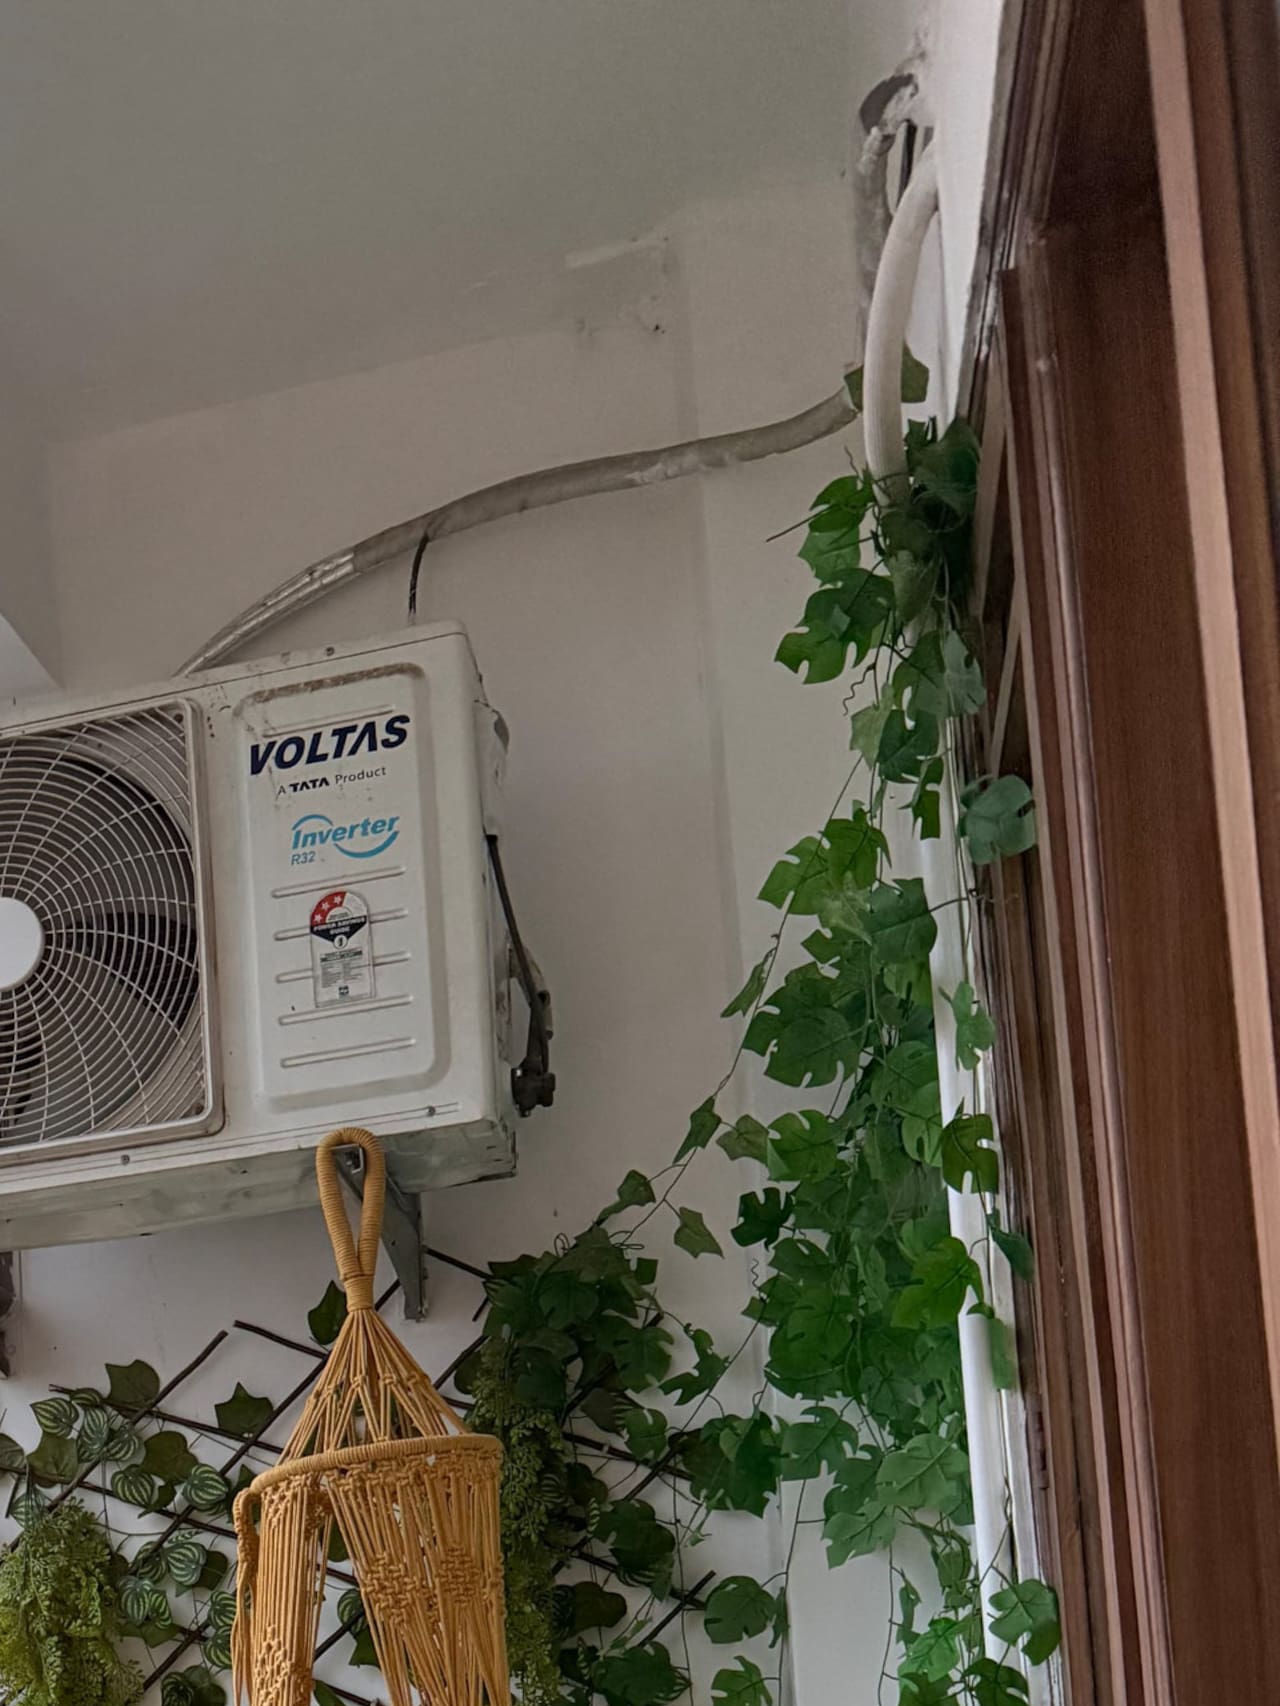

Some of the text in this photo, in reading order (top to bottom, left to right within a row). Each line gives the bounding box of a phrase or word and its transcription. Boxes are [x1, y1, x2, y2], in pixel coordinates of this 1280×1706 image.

[250, 715, 410, 775] VOLTAS
[277, 766, 387, 796] A TATA Product
[291, 815, 400, 850] Inverter
[291, 851, 316, 866] R32
